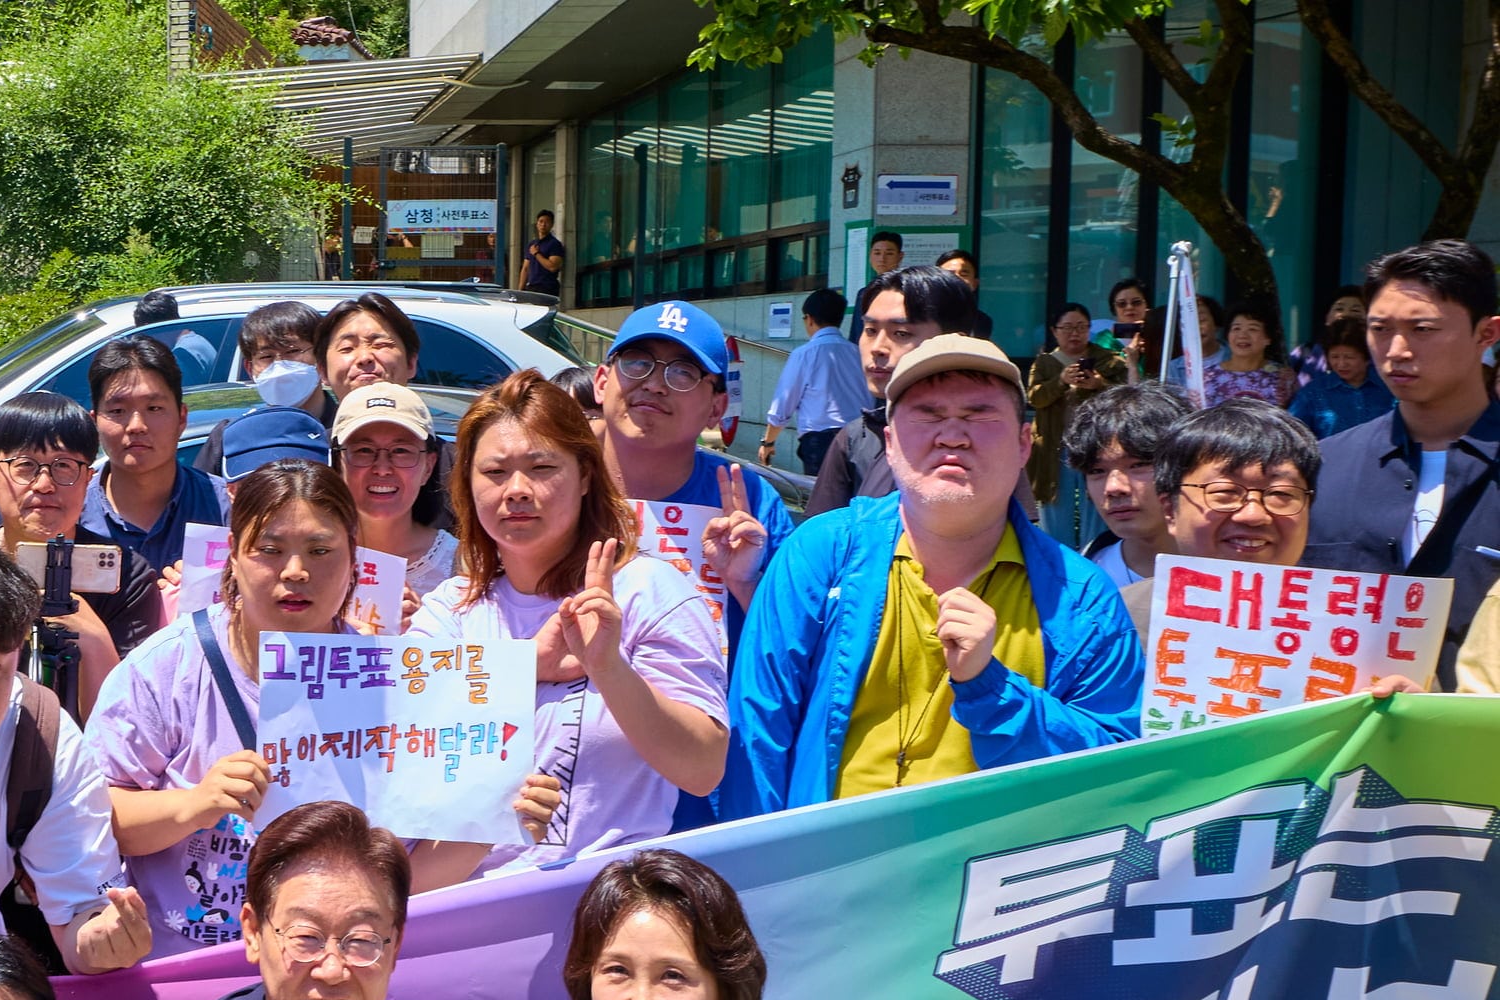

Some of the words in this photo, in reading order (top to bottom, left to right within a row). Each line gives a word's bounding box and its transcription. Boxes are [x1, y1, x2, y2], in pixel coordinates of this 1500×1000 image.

[405, 209, 433, 224] 삼청
[441, 209, 490, 220] 사전투표소
[657, 303, 689, 333] LA
[1164, 565, 1429, 662] 대통령은
[934, 765, 1496, 986] 투표는
